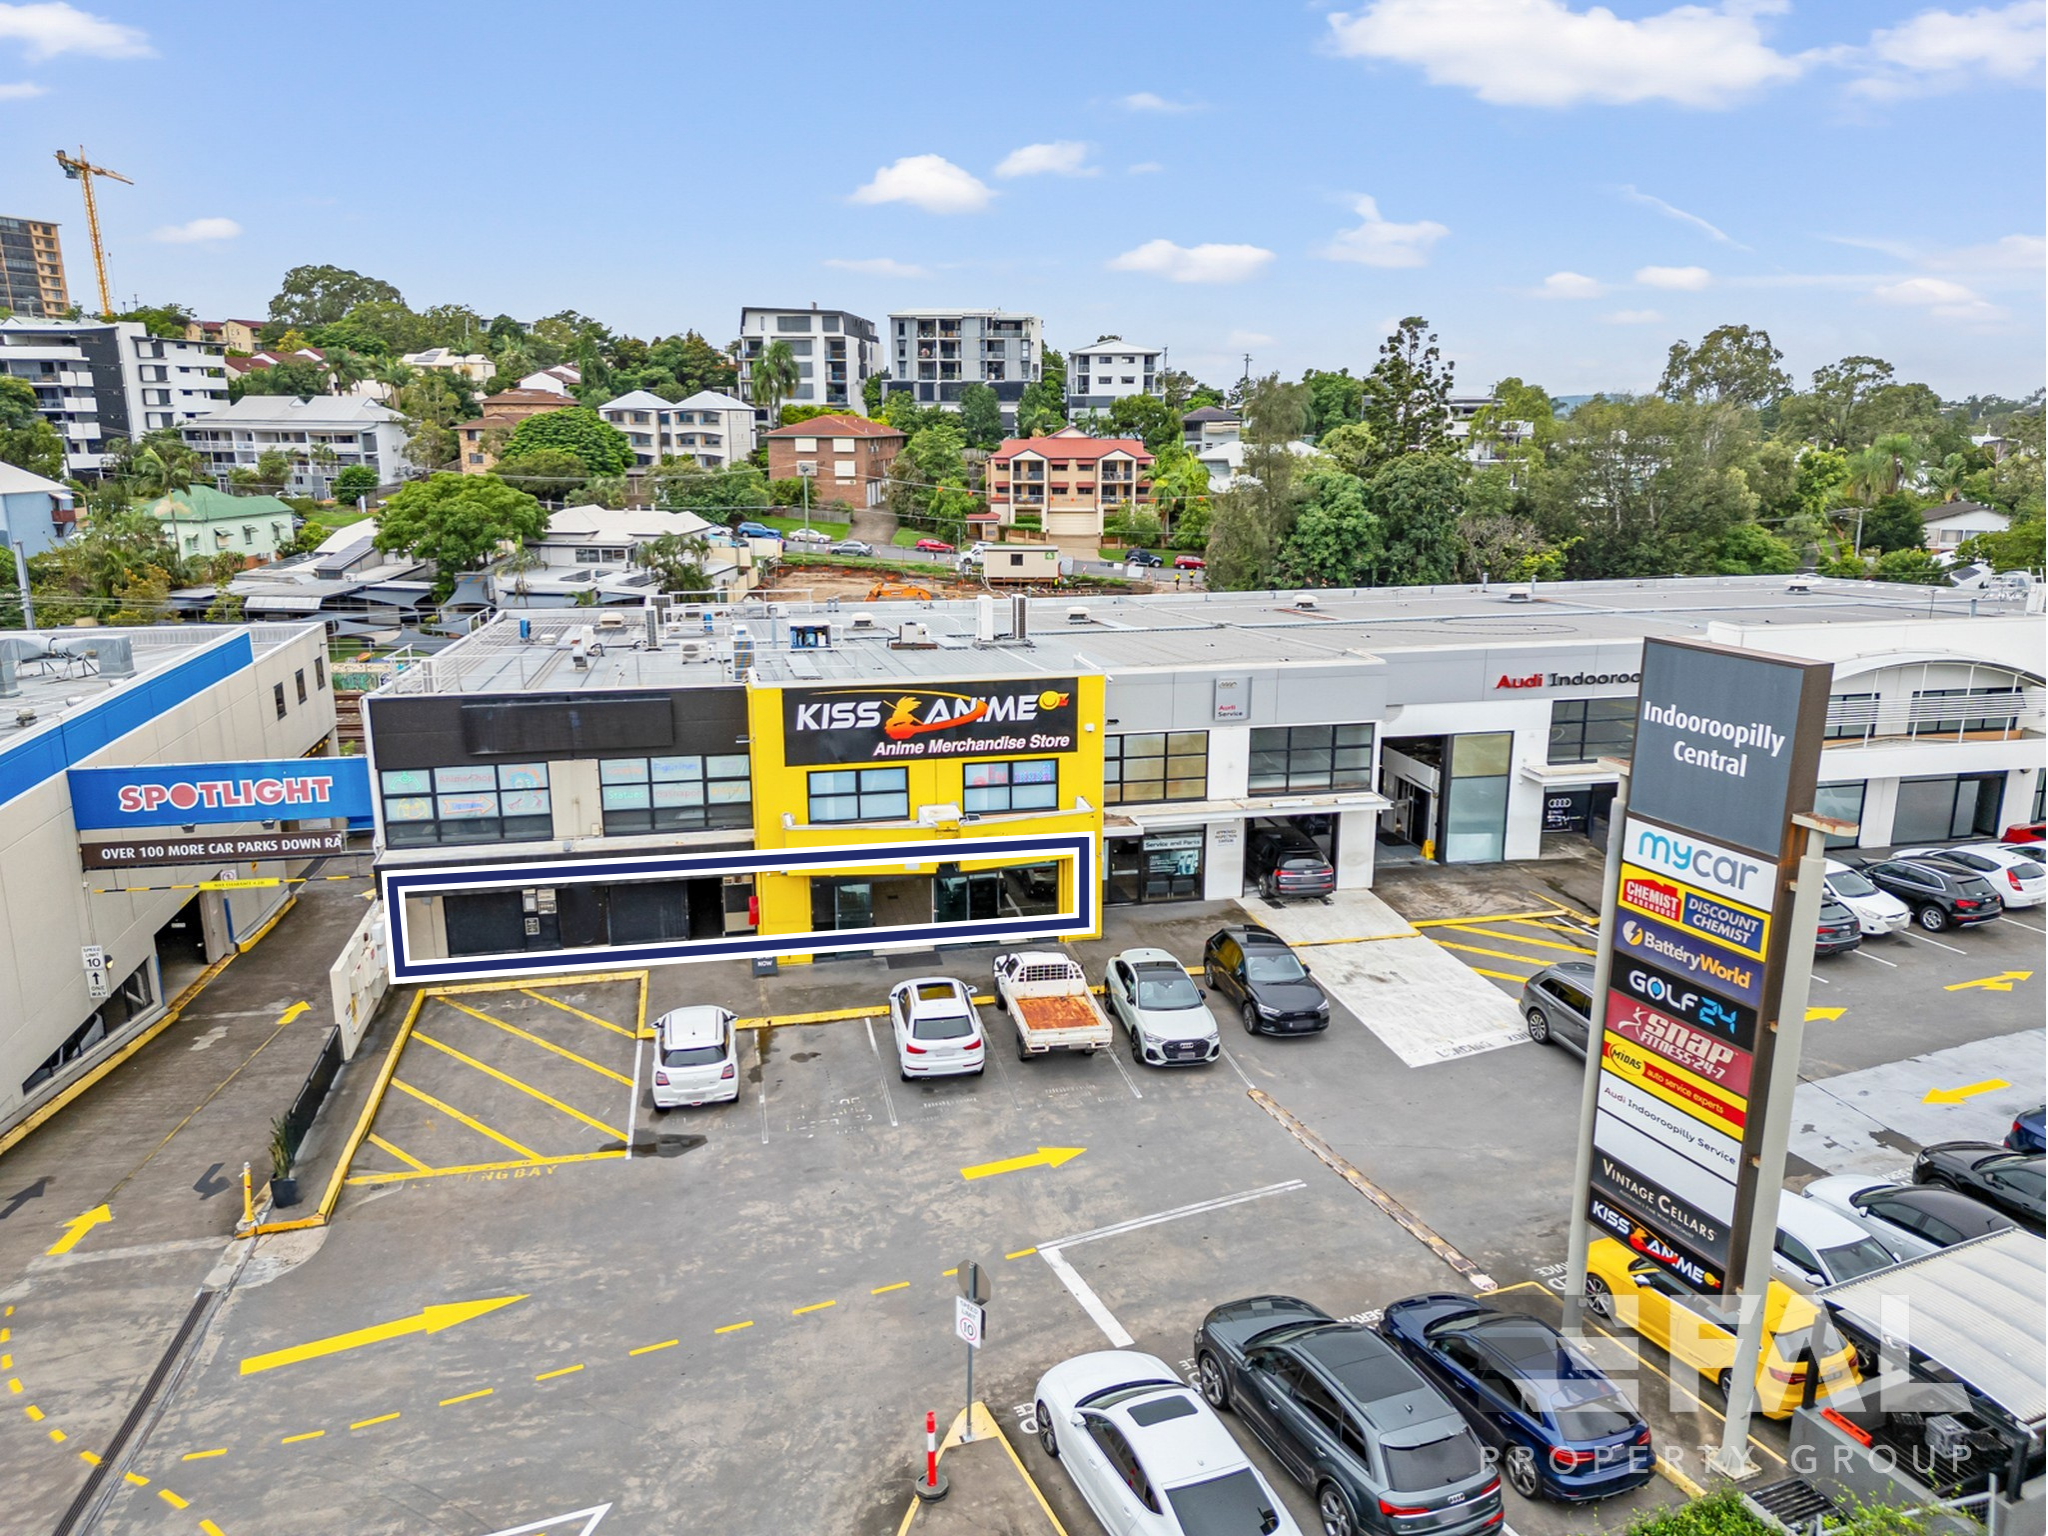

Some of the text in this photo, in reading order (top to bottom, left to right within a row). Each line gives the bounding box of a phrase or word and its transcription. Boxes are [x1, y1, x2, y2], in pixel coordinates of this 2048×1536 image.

[1495, 674, 1543, 689] Audi
[796, 701, 882, 731] KISS
[1643, 700, 1786, 758] Indooroopilly
[872, 733, 1070, 757] Anime Merchandise Store
[1673, 740, 1748, 778] Central
[118, 776, 333, 812] SPOTLIGHT
[102, 846, 135, 860] OVER
[138, 844, 164, 858] 100
[167, 843, 206, 857] MORE
[207, 841, 235, 855] CAR
[236, 839, 279, 853] PARKS
[281, 838, 322, 851] DOWN
[1637, 831, 1759, 890] mycar
[1625, 880, 1679, 912] CHEMIST
[1688, 897, 1759, 933] DISCOUNT
[1692, 914, 1752, 944] CHEMIST
[86, 957, 101, 968] 10
[1628, 969, 1737, 1034] GOLF 24
[1612, 1048, 1642, 1070] MIDAS
[1647, 1069, 1725, 1115] auto service experts
[1604, 1087, 1737, 1166] Audi Indooroopilly Service
[1591, 1200, 1631, 1235] KISS
[1602, 1158, 1716, 1242] VINTAGE CELLARS
[963, 1321, 974, 1336] 10
